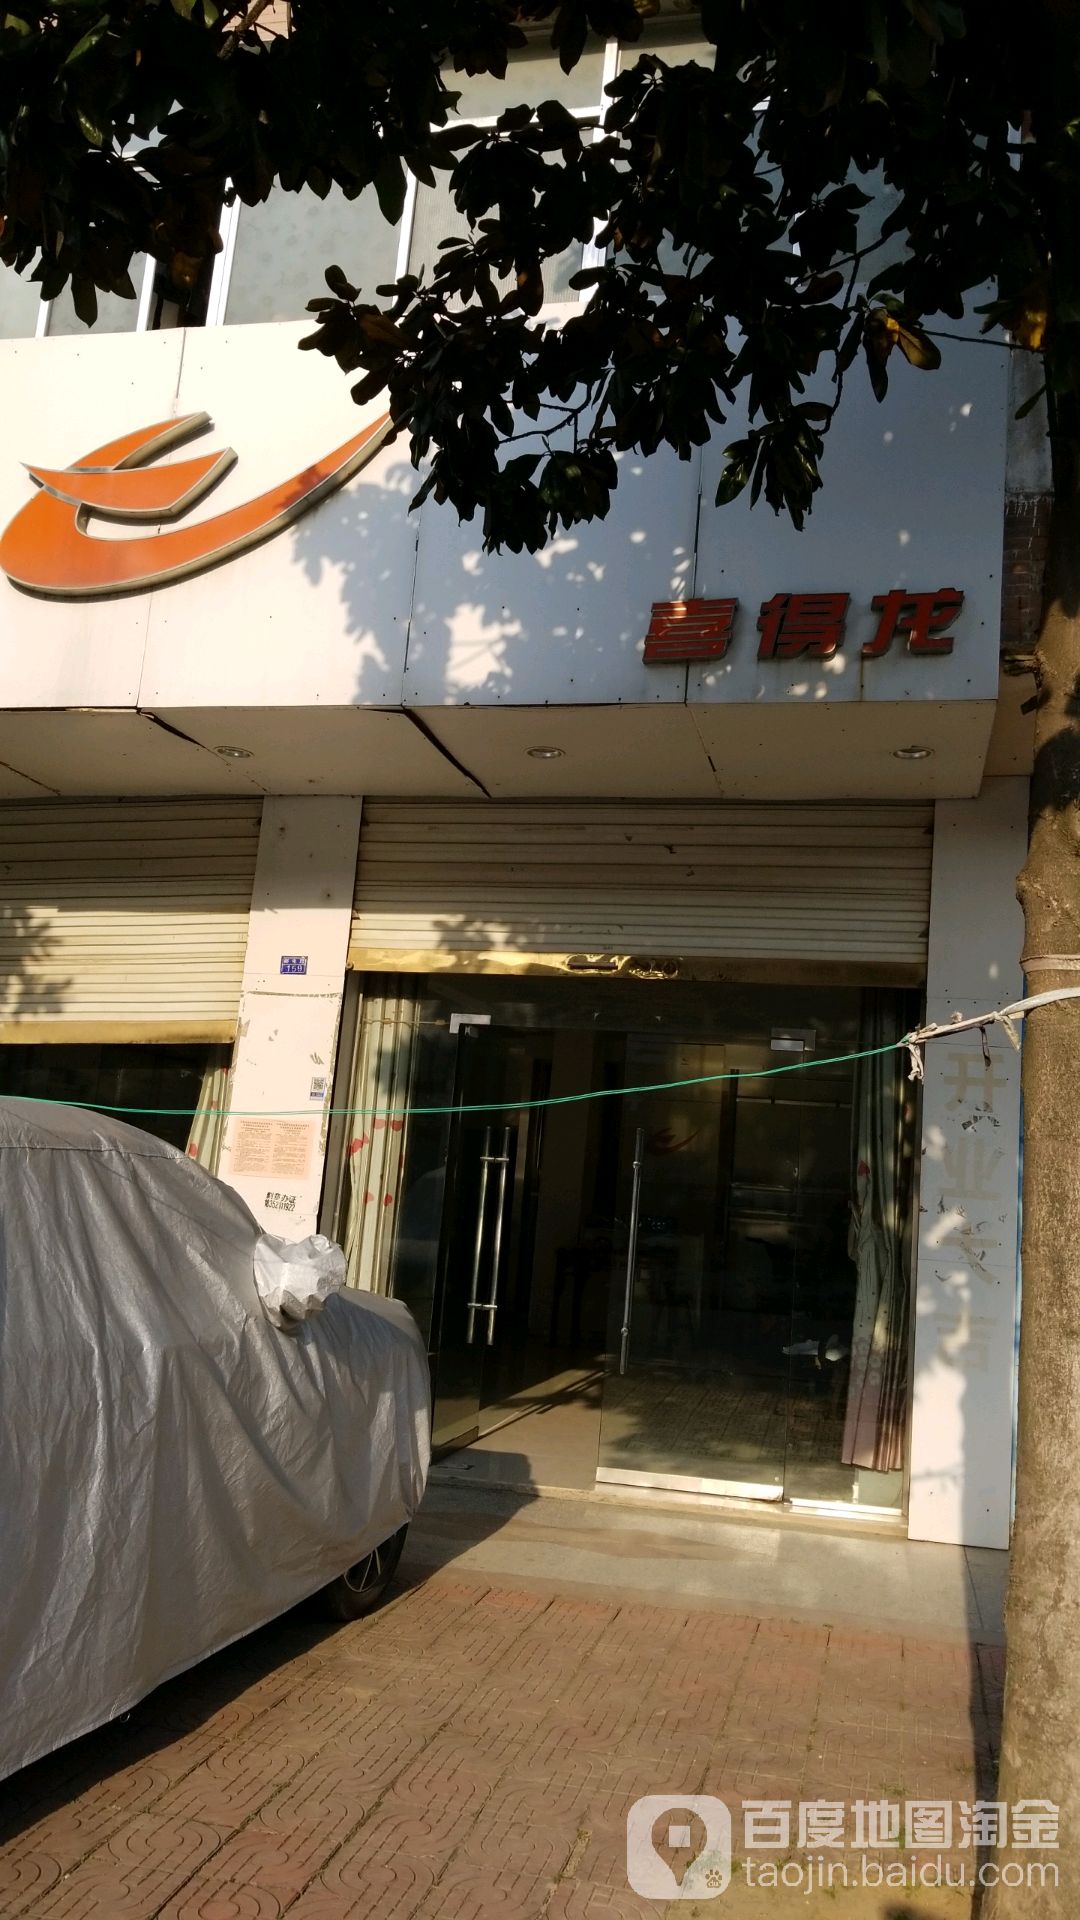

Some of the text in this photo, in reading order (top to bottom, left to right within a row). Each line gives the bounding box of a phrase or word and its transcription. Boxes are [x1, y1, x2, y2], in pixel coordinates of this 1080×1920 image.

[642, 587, 965, 664] 喜得龙
[286, 965, 303, 973] 159
